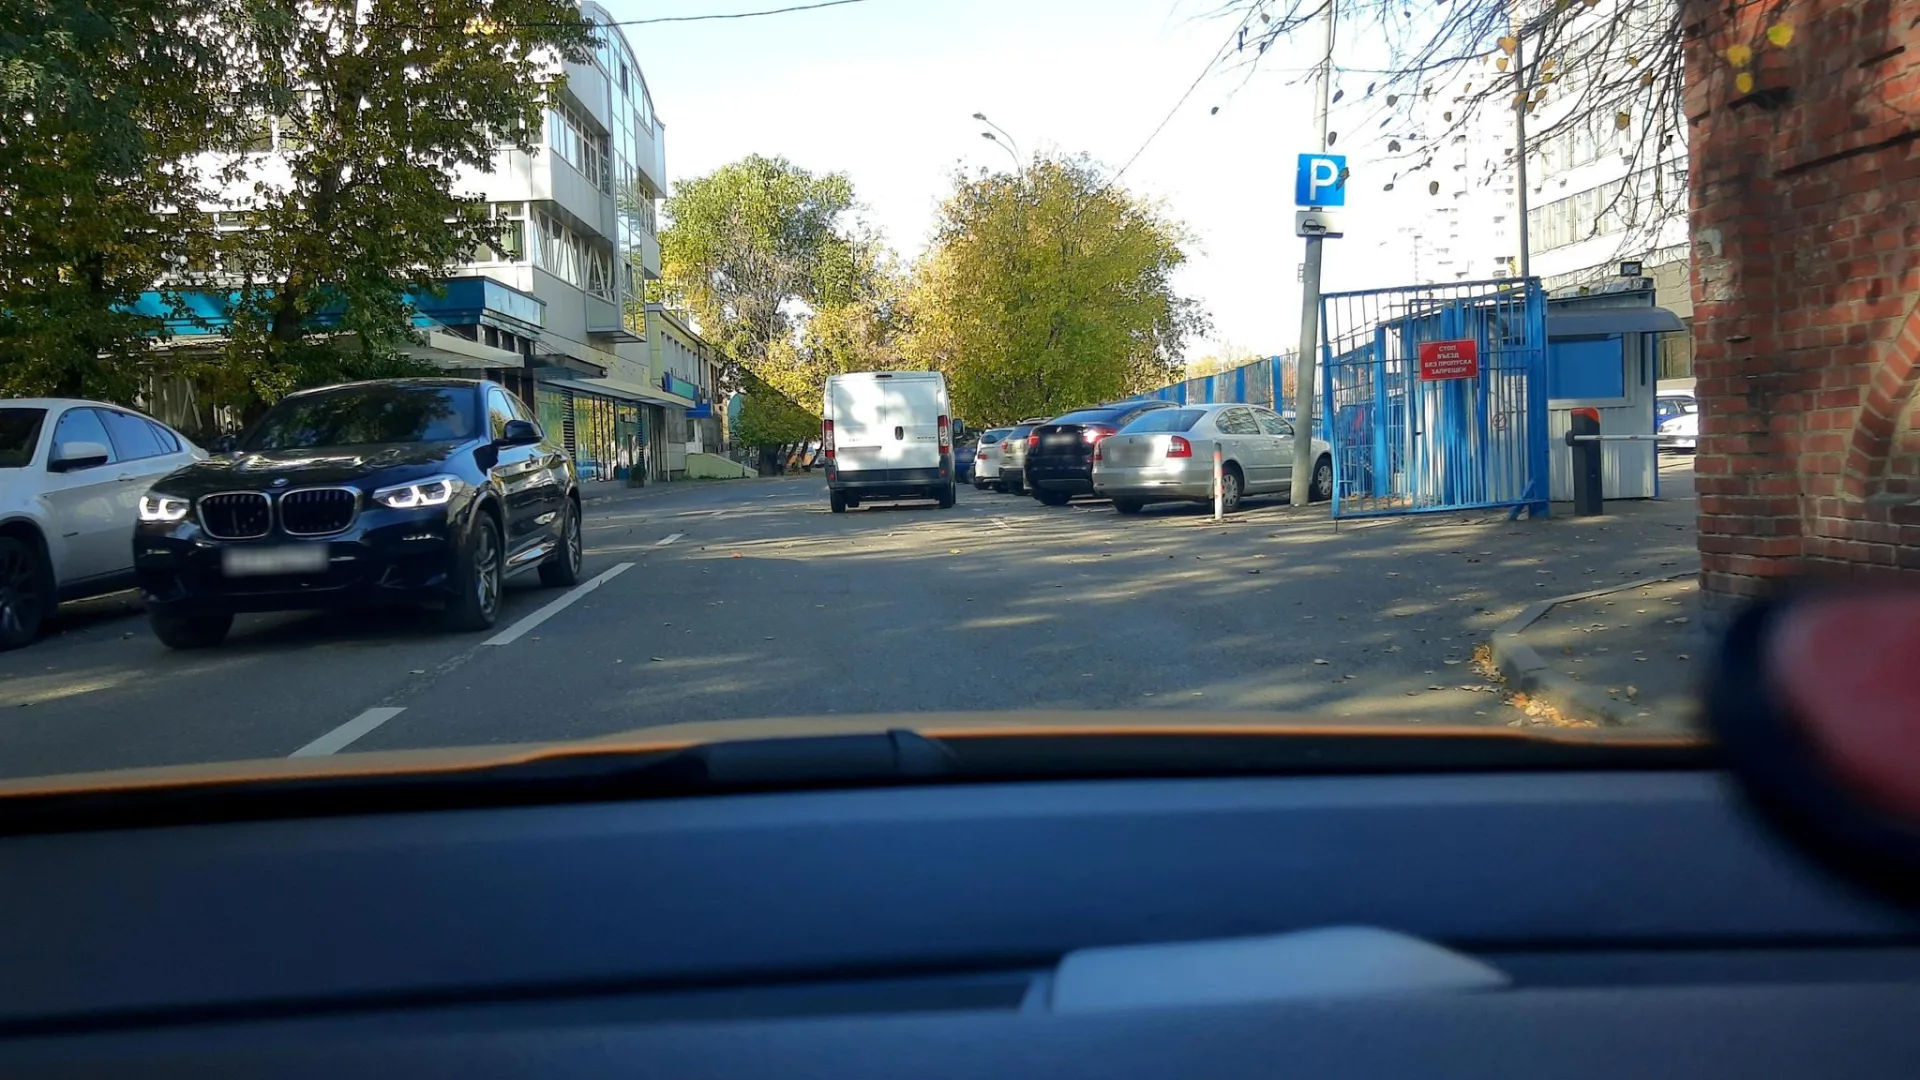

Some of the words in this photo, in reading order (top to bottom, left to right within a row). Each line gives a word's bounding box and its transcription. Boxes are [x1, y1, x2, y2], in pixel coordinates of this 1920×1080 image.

[1309, 158, 1338, 200] P
[1438, 359, 1473, 367] ПРОПУСКА
[1431, 367, 1467, 375] ЗАПРЕЩЕН
